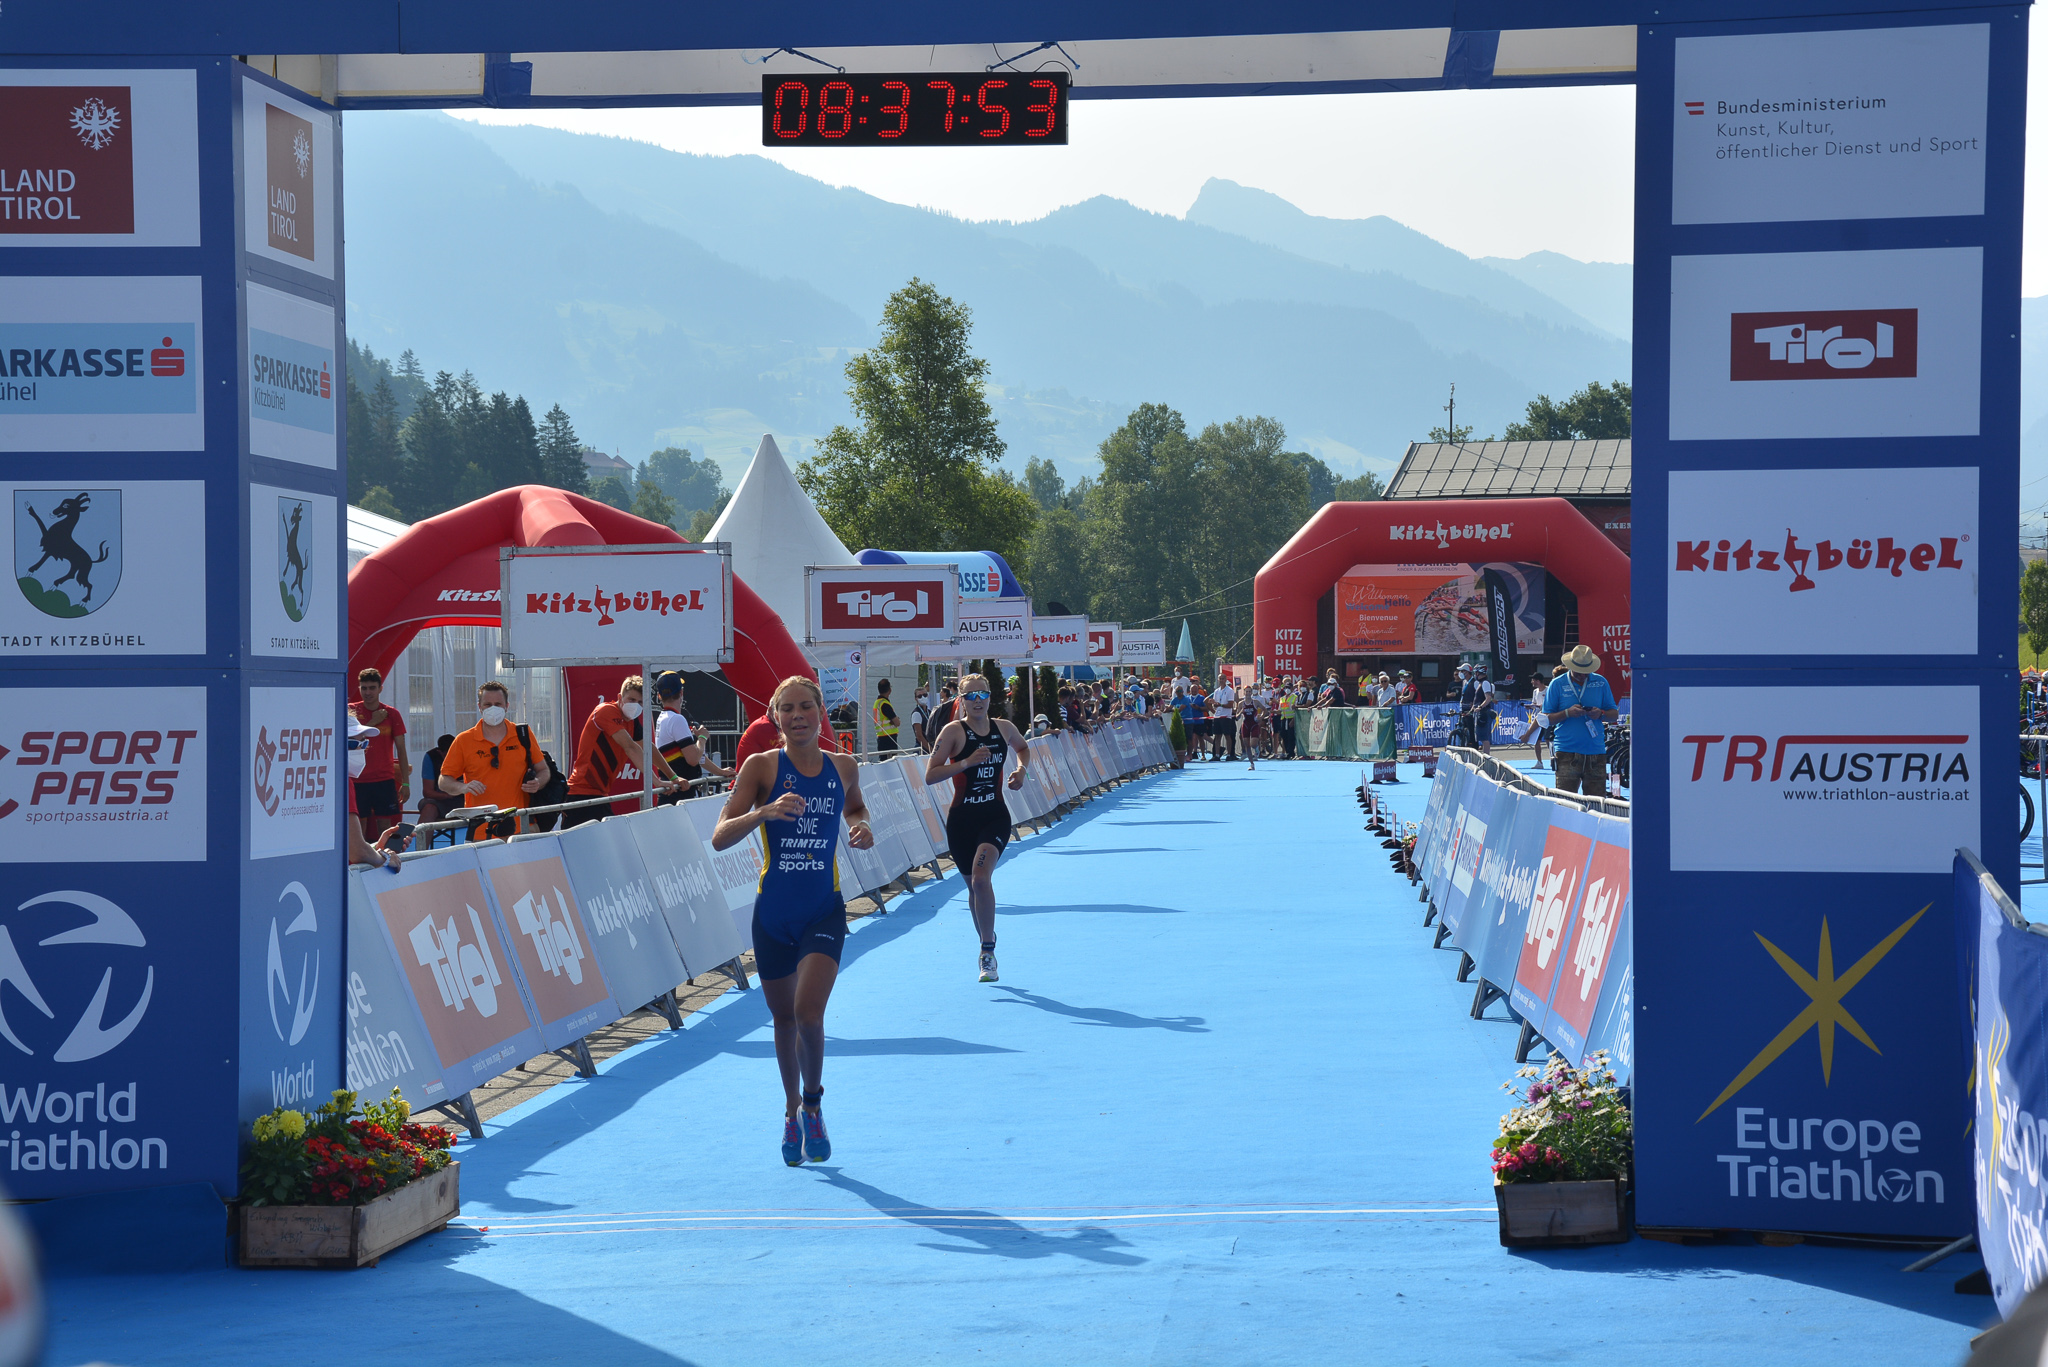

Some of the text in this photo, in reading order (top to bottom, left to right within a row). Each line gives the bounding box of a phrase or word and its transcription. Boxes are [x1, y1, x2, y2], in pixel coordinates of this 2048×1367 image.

[773, 80, 1057, 138] 08:37:53
[1716, 95, 1887, 116] Bundesministerium
[1716, 119, 1835, 138] Kunst, Kultur,
[1715, 136, 1979, 160] öffentlicher Dienst und Sport
[0, 169, 76, 192] LAND
[0, 197, 81, 220] TIROL
[270, 184, 297, 215] LAND
[270, 211, 299, 243] TIROL
[1753, 321, 1894, 369] Tirol
[253, 353, 319, 397] SPARKASSE
[253, 386, 286, 412] Kitzbühel
[1390, 522, 1512, 544] Kitzbühel
[1675, 533, 1963, 581] Kitzbühel
[526, 588, 705, 618] Kitzbühel
[836, 589, 929, 622] Tirol
[1345, 602, 1391, 611] Welcome
[1384, 598, 1412, 607] Hello
[958, 620, 1023, 633] AUSTRIA
[1275, 629, 1303, 641] KITZ
[50, 632, 146, 647] KITZBÜHEL
[270, 637, 320, 650] STADT KITZBÜHEL
[1121, 642, 1160, 651] AUSTRIA
[1275, 643, 1303, 656] BUE
[1346, 637, 1403, 646] Willkommen
[1275, 659, 1303, 671] HEL.
[1422, 718, 1451, 729] Europe
[1498, 715, 1519, 727] Europe
[16, 730, 198, 766] SPORT
[277, 727, 333, 763] SPORT
[1681, 734, 1970, 783] TRI AUSTRIA
[282, 766, 328, 801] PASS
[977, 766, 995, 779] NED
[29, 770, 180, 806] PASS
[963, 792, 995, 804] HUUB
[1783, 787, 1970, 802] www.triathlon-austria.at
[25, 808, 170, 825] sportpassaustria.at
[280, 803, 325, 818] sportpassaustria.at
[796, 817, 819, 835] SWE
[780, 838, 829, 849] TRIMTEX
[778, 859, 825, 873] sports
[512, 885, 585, 986] Tirol
[408, 903, 502, 1018] Tirol
[271, 1059, 315, 1109] World
[0, 1081, 137, 1124] World
[1736, 1107, 1922, 1160] Europe
[1716, 1154, 1945, 1204] Triathlon
